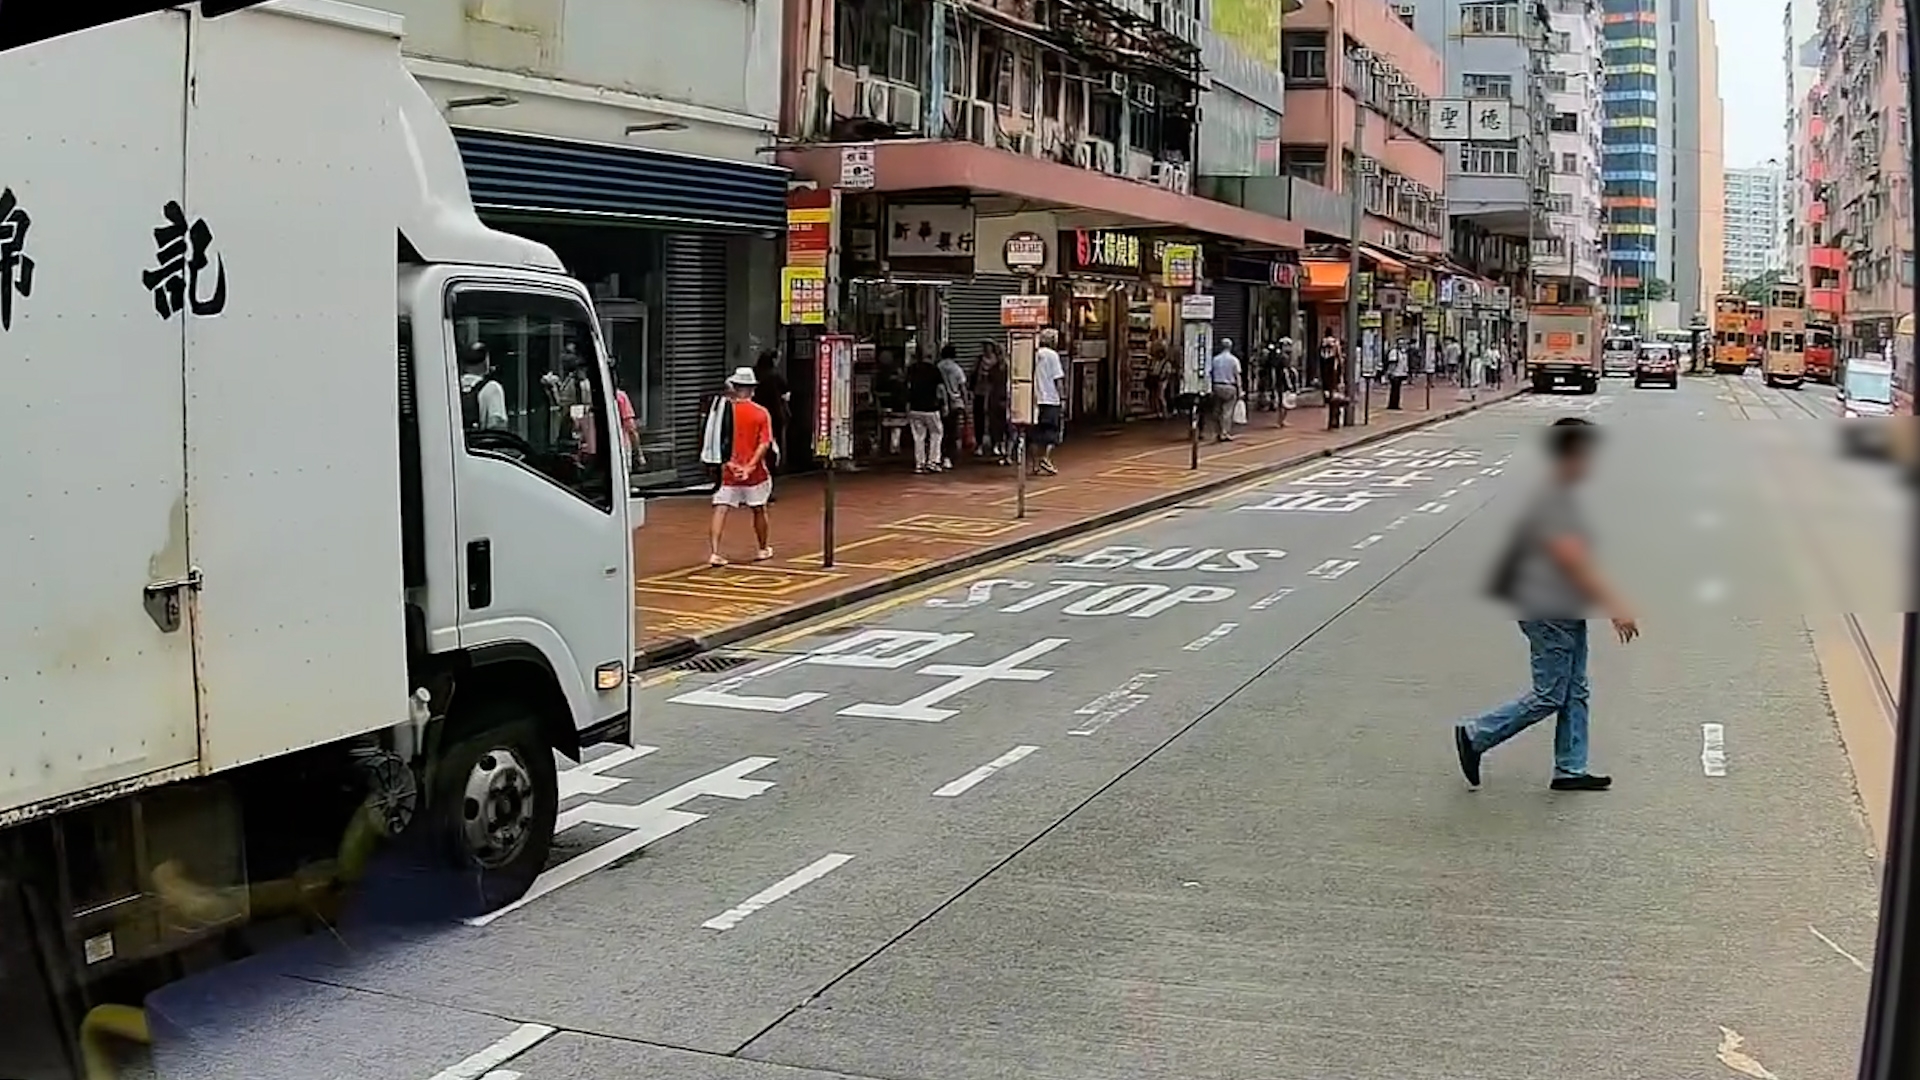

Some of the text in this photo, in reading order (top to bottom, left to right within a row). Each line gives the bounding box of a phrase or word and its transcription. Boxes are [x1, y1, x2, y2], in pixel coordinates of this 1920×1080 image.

[1441, 106, 1501, 131] 聖德
[1335, 456, 1480, 469] STOP
[1288, 469, 1435, 488] 巴士
[1064, 545, 1288, 573] BUS
[925, 578, 1237, 618] STOP
[667, 628, 1071, 723] 巴士
